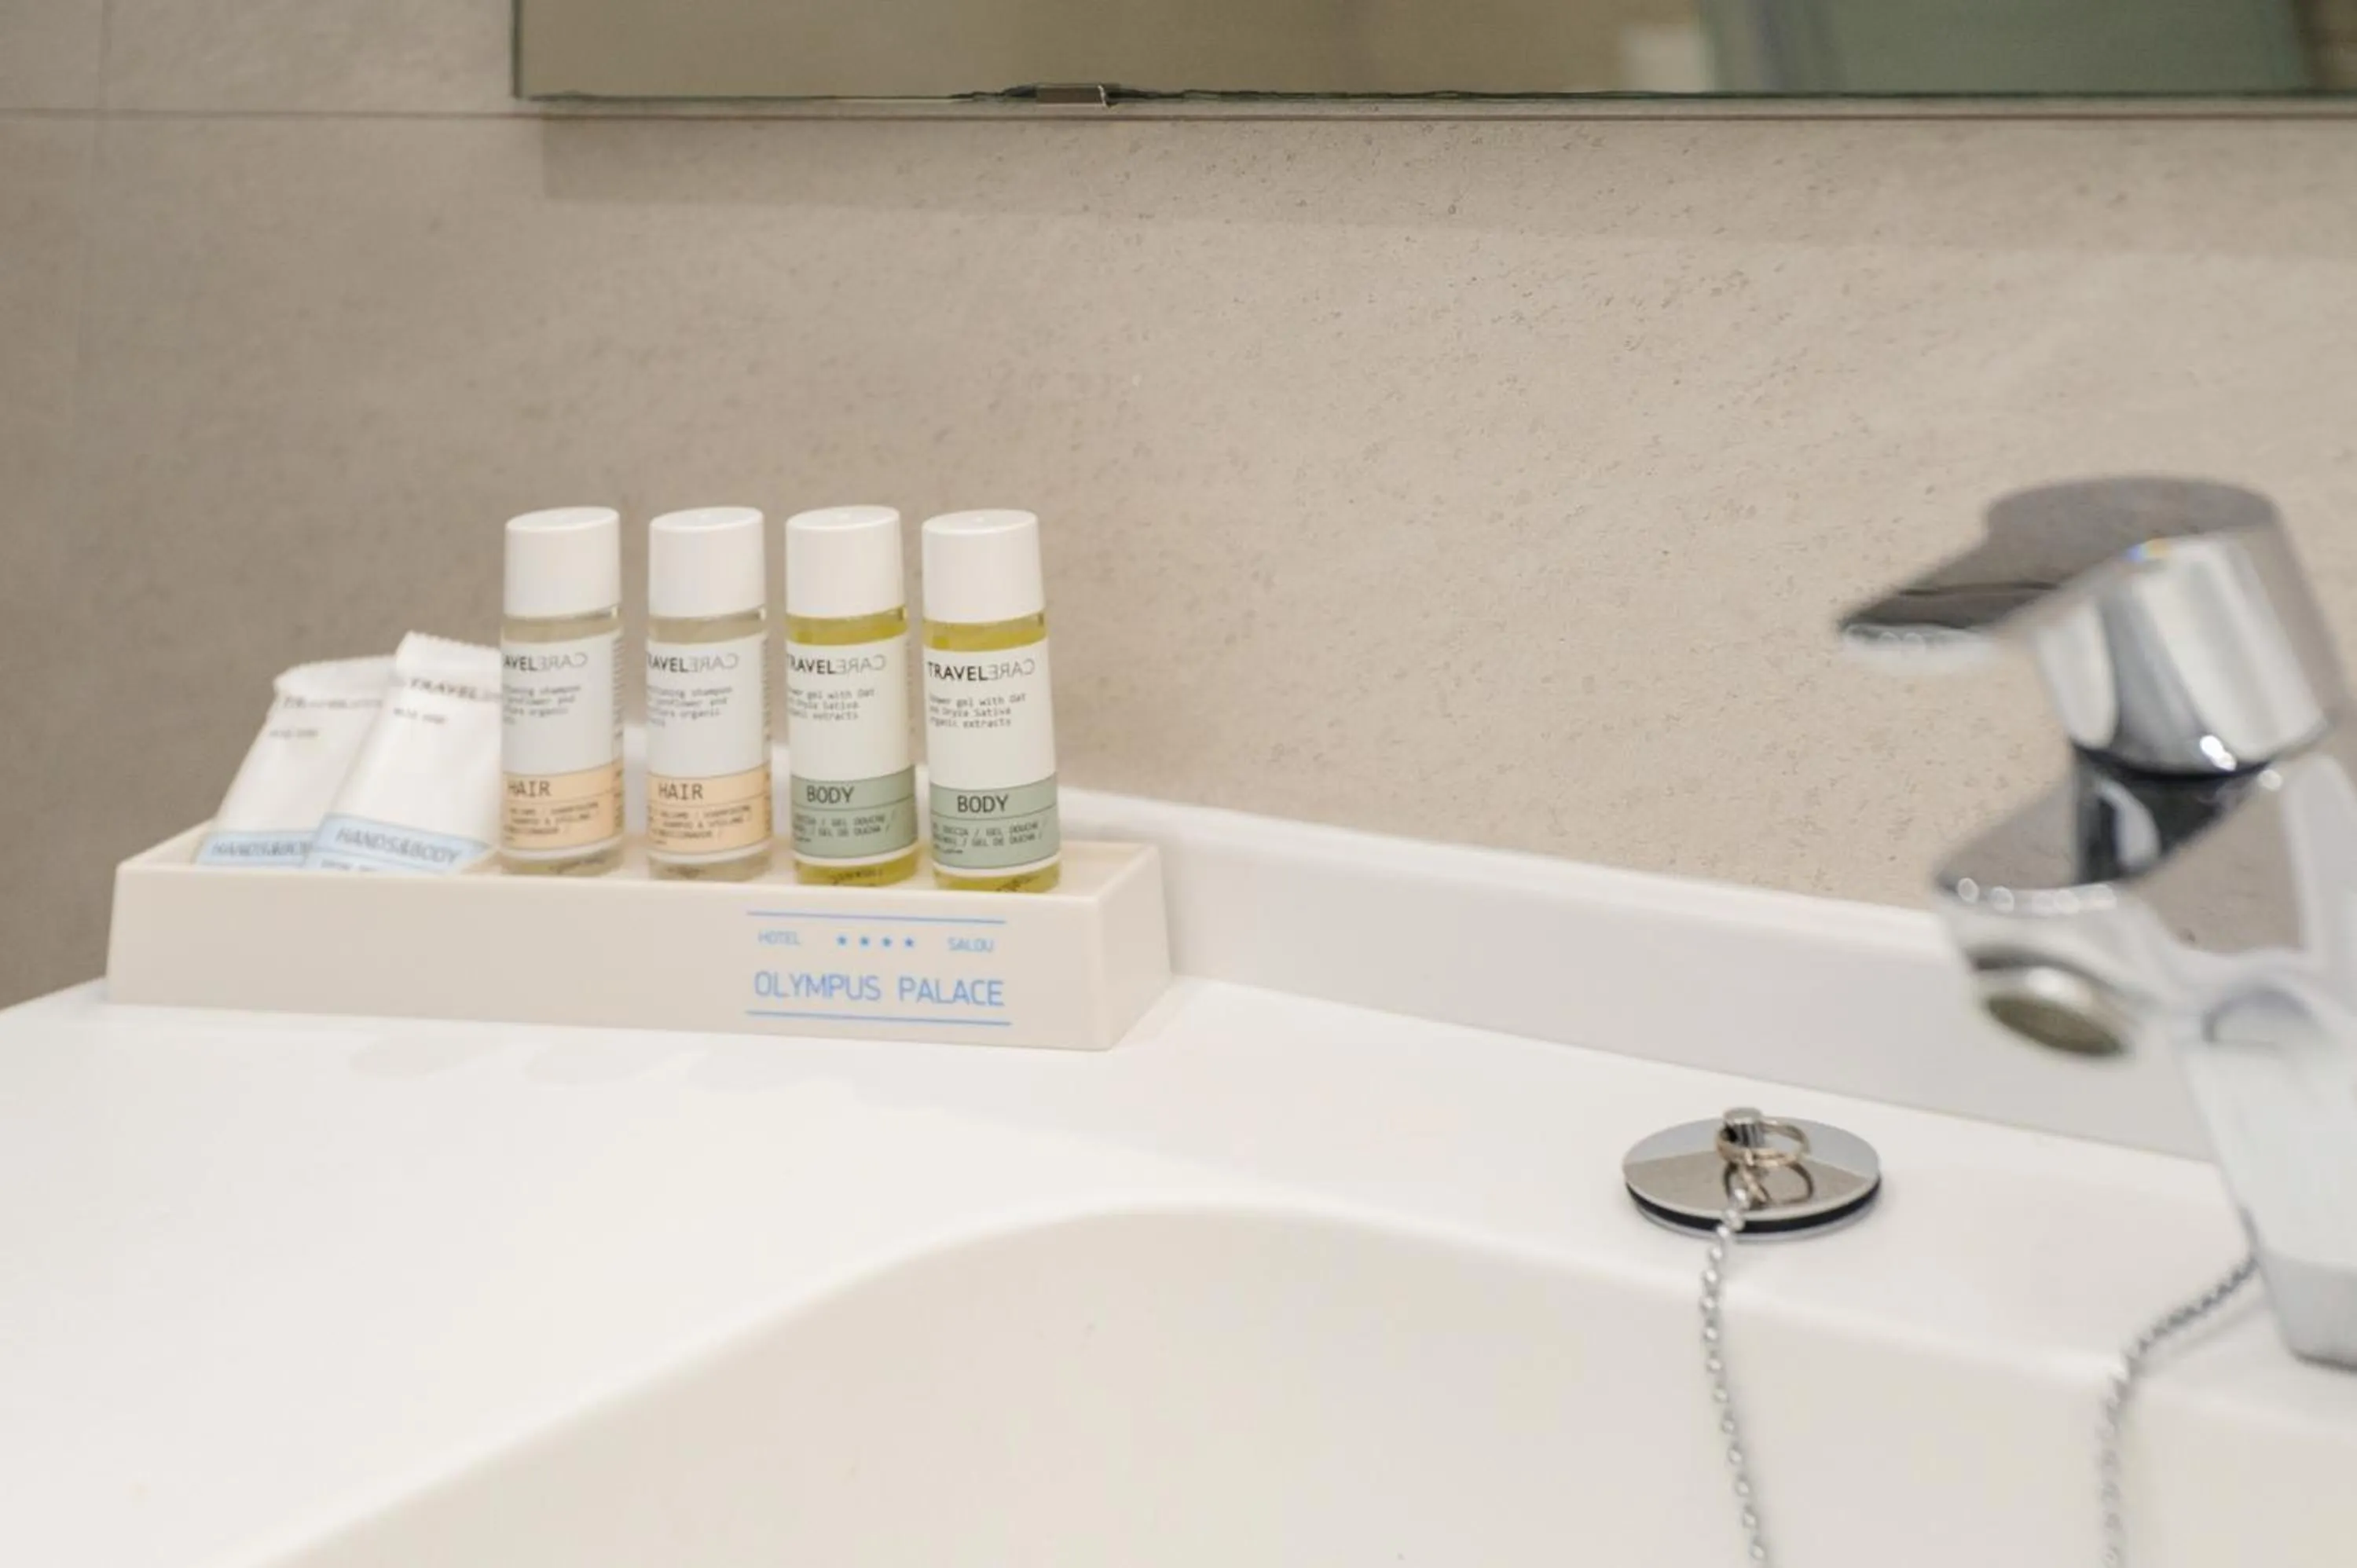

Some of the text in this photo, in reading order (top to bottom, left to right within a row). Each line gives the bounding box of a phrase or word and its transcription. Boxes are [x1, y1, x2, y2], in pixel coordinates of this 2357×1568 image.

[927, 660, 988, 682] TRAVEL
[507, 780, 552, 798] HAIR
[658, 782, 704, 800] HAIR
[806, 786, 855, 804] BODY
[957, 794, 1010, 813] BODY
[757, 930, 995, 954] HOTEL SALOU
[753, 970, 1006, 1007] OLYMPUS PALACE
